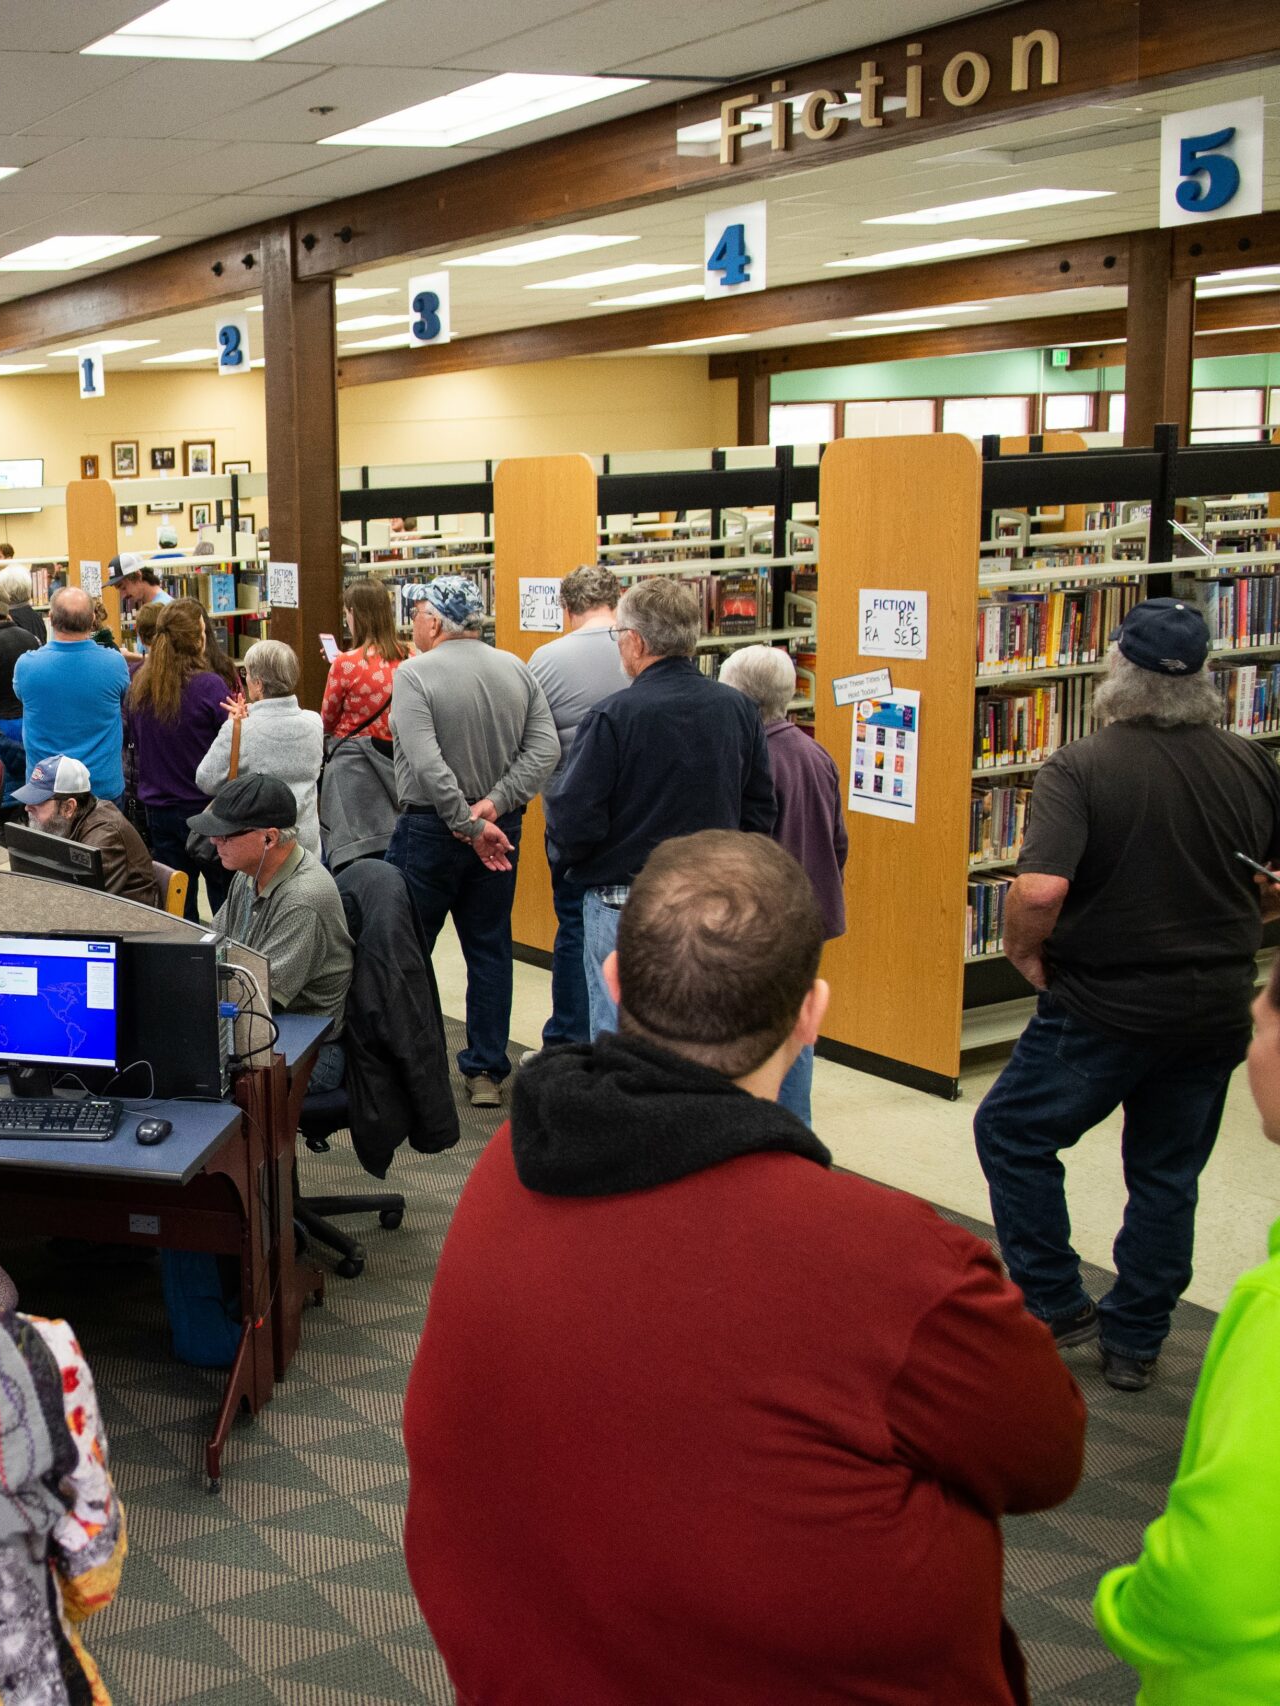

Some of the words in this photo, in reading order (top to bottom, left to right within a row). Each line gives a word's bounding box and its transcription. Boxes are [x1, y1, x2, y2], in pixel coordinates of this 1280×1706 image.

[719, 28, 1060, 165] Fiction
[1175, 126, 1241, 213] 5
[707, 223, 752, 286] 4
[413, 291, 441, 340] 3
[219, 325, 243, 366] 2
[81, 357, 97, 393] 1
[528, 585, 555, 594] FICTION
[873, 599, 915, 612] FICTION
[865, 627, 880, 642] RA
[894, 626, 921, 646] SEB
